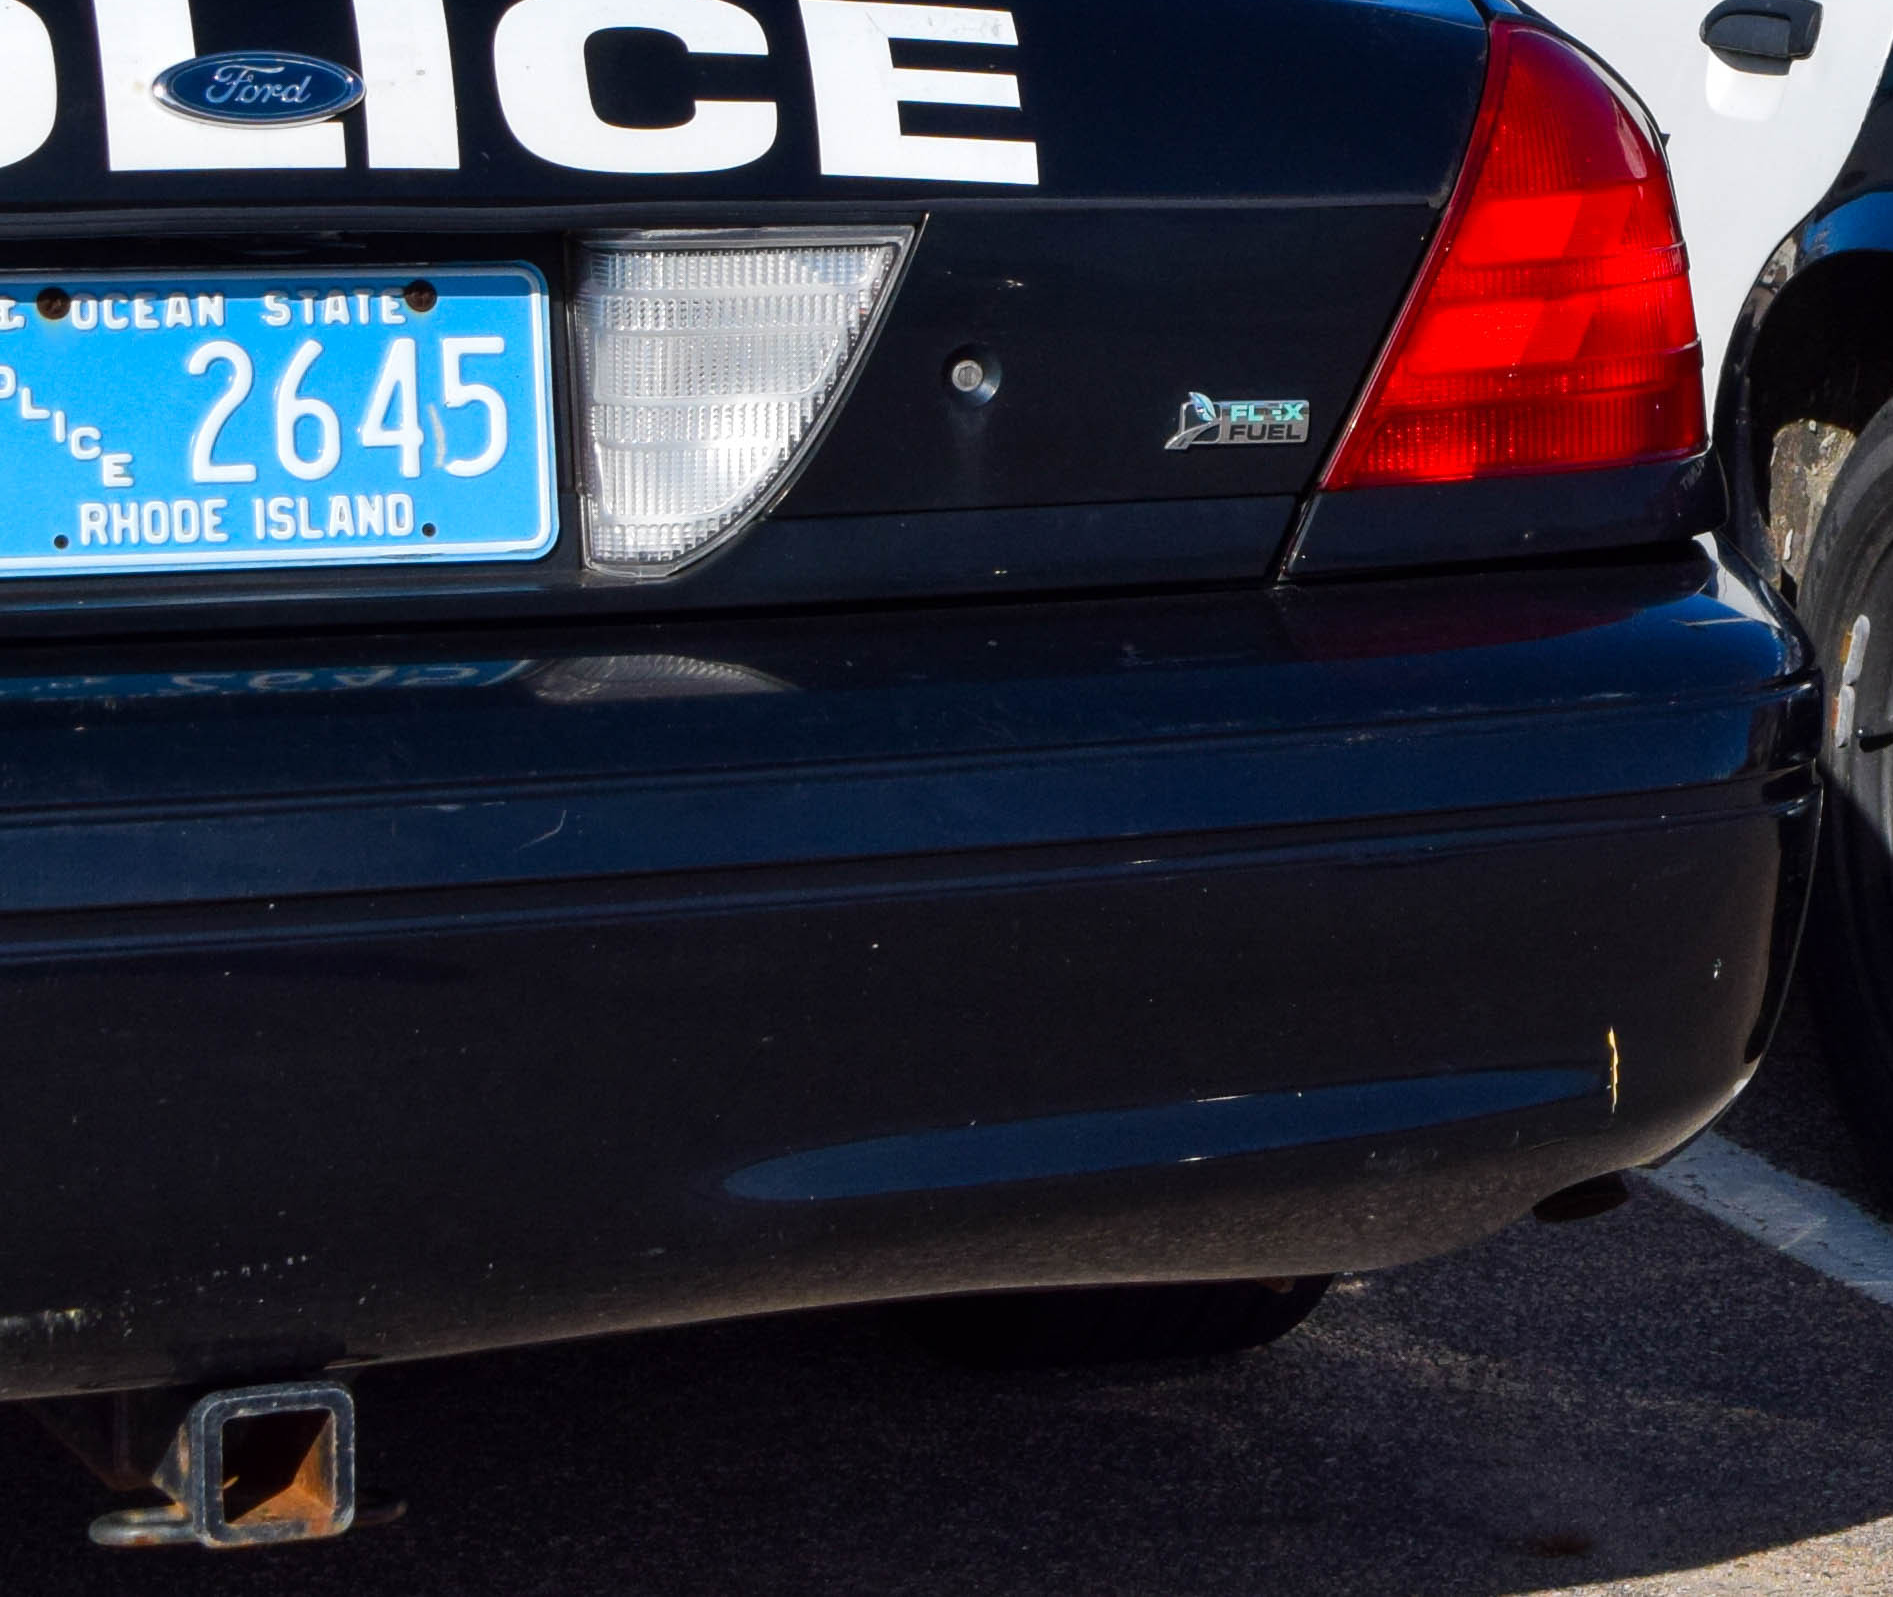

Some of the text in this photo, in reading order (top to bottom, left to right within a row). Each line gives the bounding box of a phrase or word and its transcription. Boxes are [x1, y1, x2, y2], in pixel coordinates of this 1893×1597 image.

[206, 64, 312, 103] Ford
[70, 288, 406, 330] OCEAN STATE
[187, 336, 507, 482] 2645
[1229, 424, 1300, 441] FUEL
[80, 493, 415, 546] RHODE ISLAND
